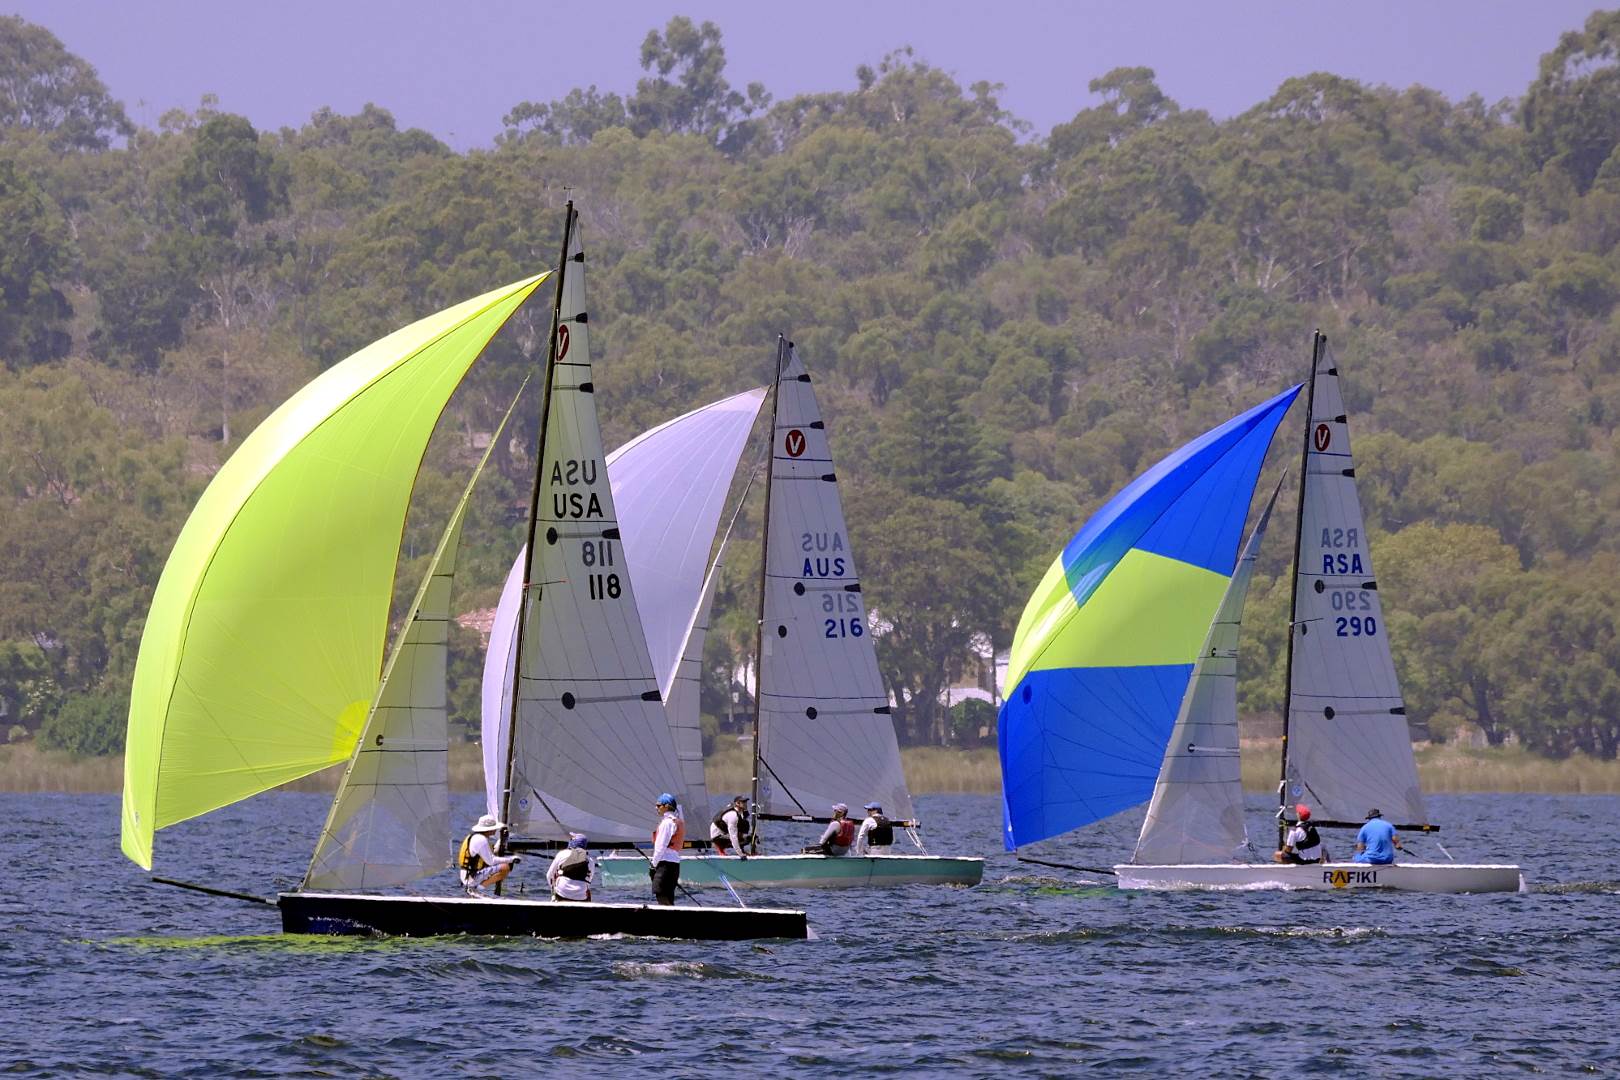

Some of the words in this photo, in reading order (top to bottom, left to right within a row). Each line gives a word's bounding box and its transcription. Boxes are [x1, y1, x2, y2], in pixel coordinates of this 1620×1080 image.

[788, 434, 803, 455] V
[1317, 428, 1329, 448] V
[553, 493, 603, 519] USA
[803, 557, 845, 577] AUS
[1323, 553, 1363, 574] RSA
[588, 573, 622, 600] 118
[824, 617, 864, 639] 216
[1335, 616, 1377, 637] 290
[1323, 871, 1377, 884] RAFIKI
